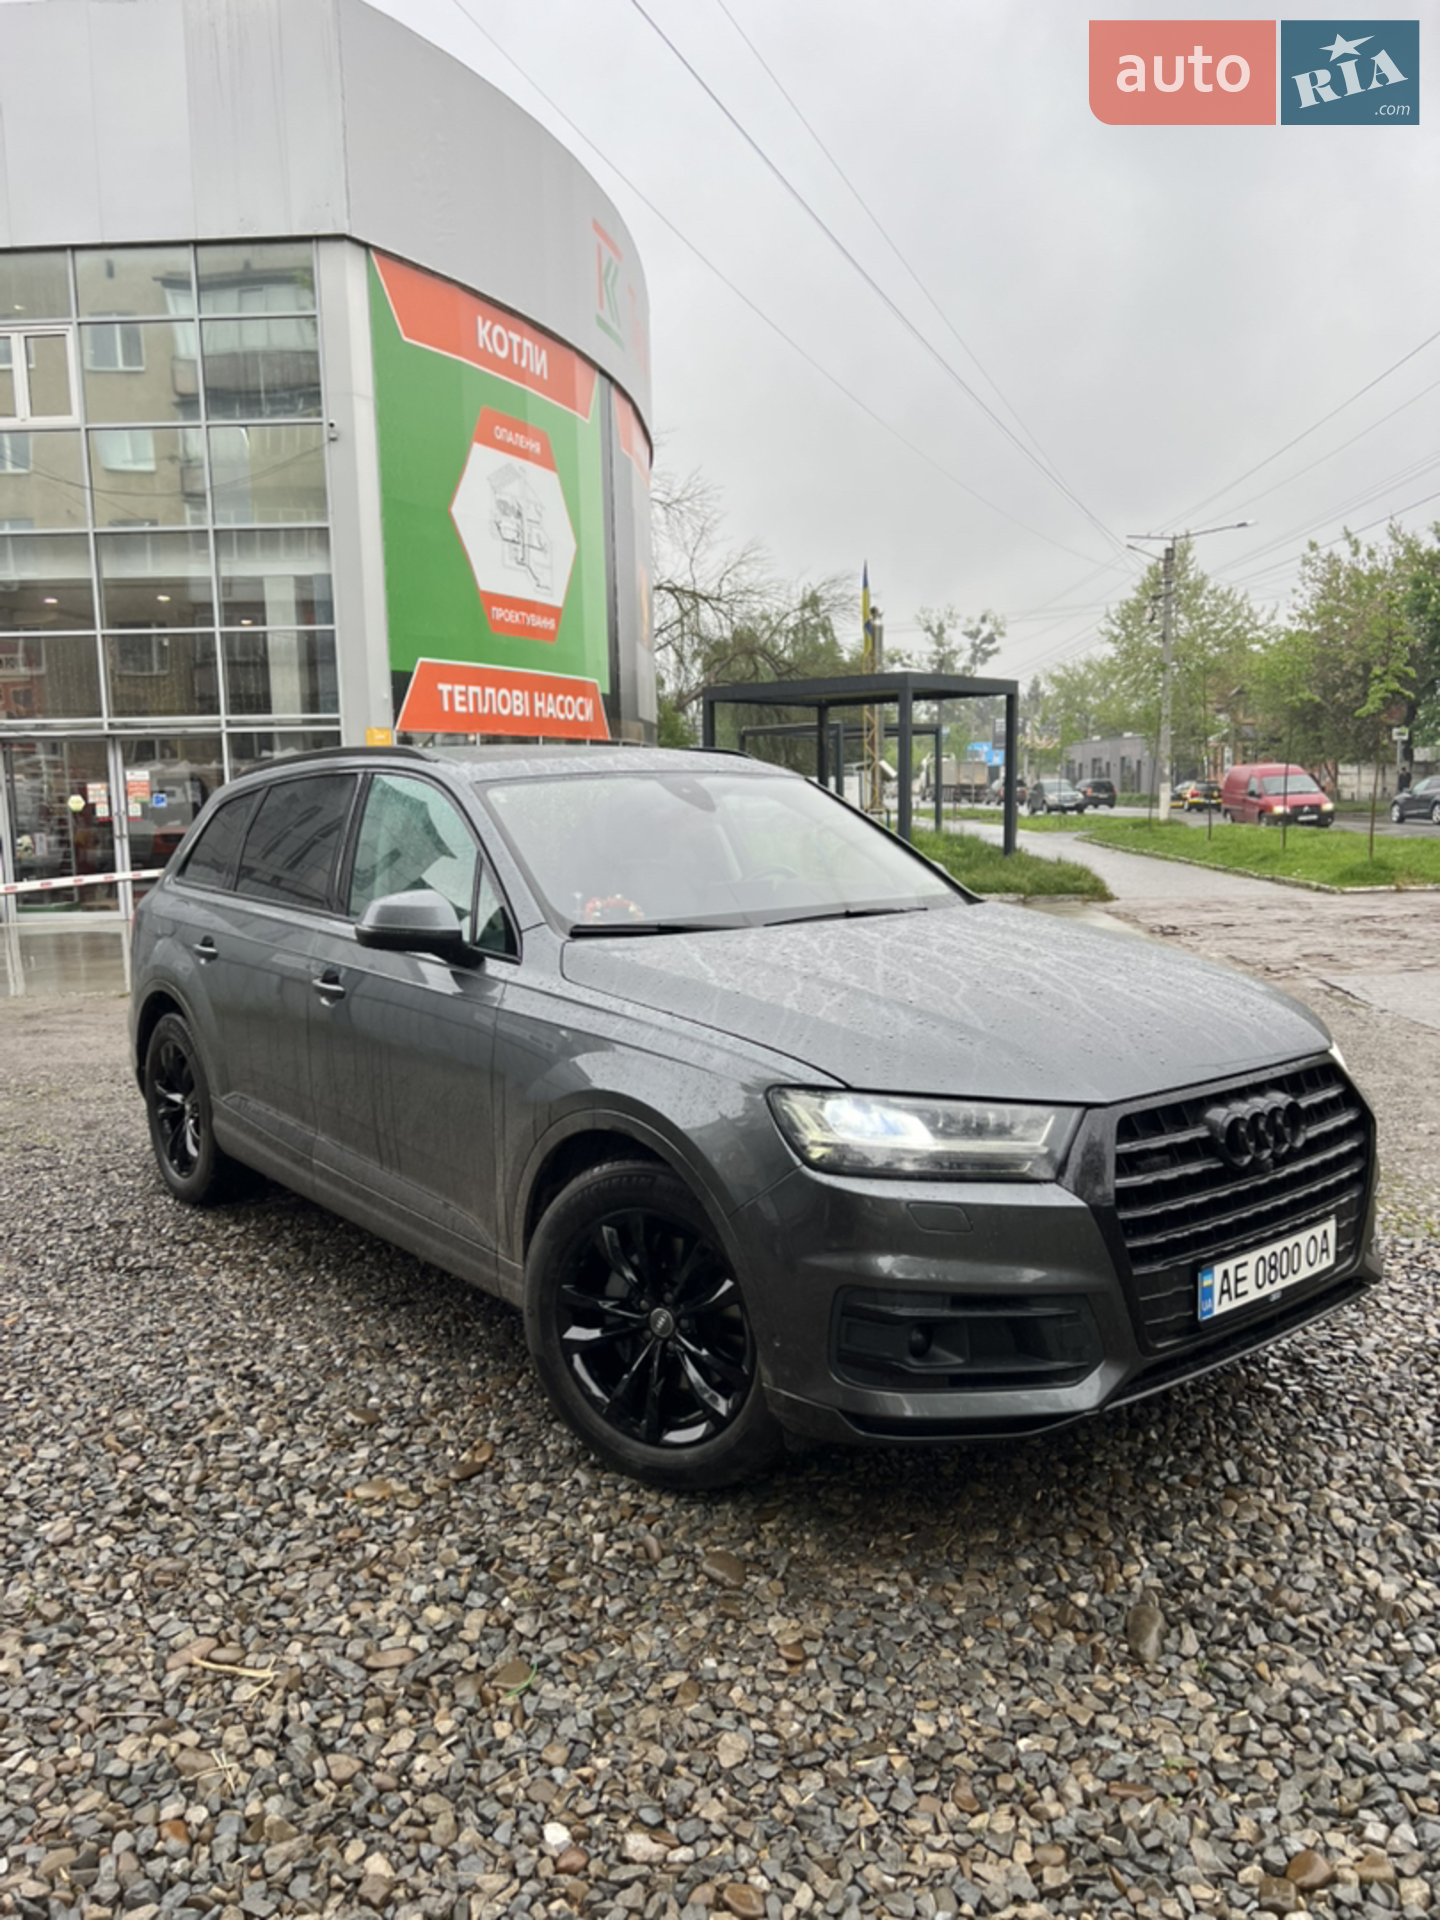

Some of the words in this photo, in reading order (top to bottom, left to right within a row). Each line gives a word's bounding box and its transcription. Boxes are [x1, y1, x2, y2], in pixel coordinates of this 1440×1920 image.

[477, 315, 548, 380] КОТЛИ
[494, 425, 541, 455] ОПАЛЕННЯ
[490, 606, 556, 630] ПРОЕКТУВАННЯ
[437, 682, 530, 718] ТЕПЛОВІ
[533, 691, 594, 722] НАСОСИ
[1218, 1261, 1249, 1306] AE
[1255, 1242, 1301, 1290] 0800
[1306, 1228, 1330, 1268] OA
